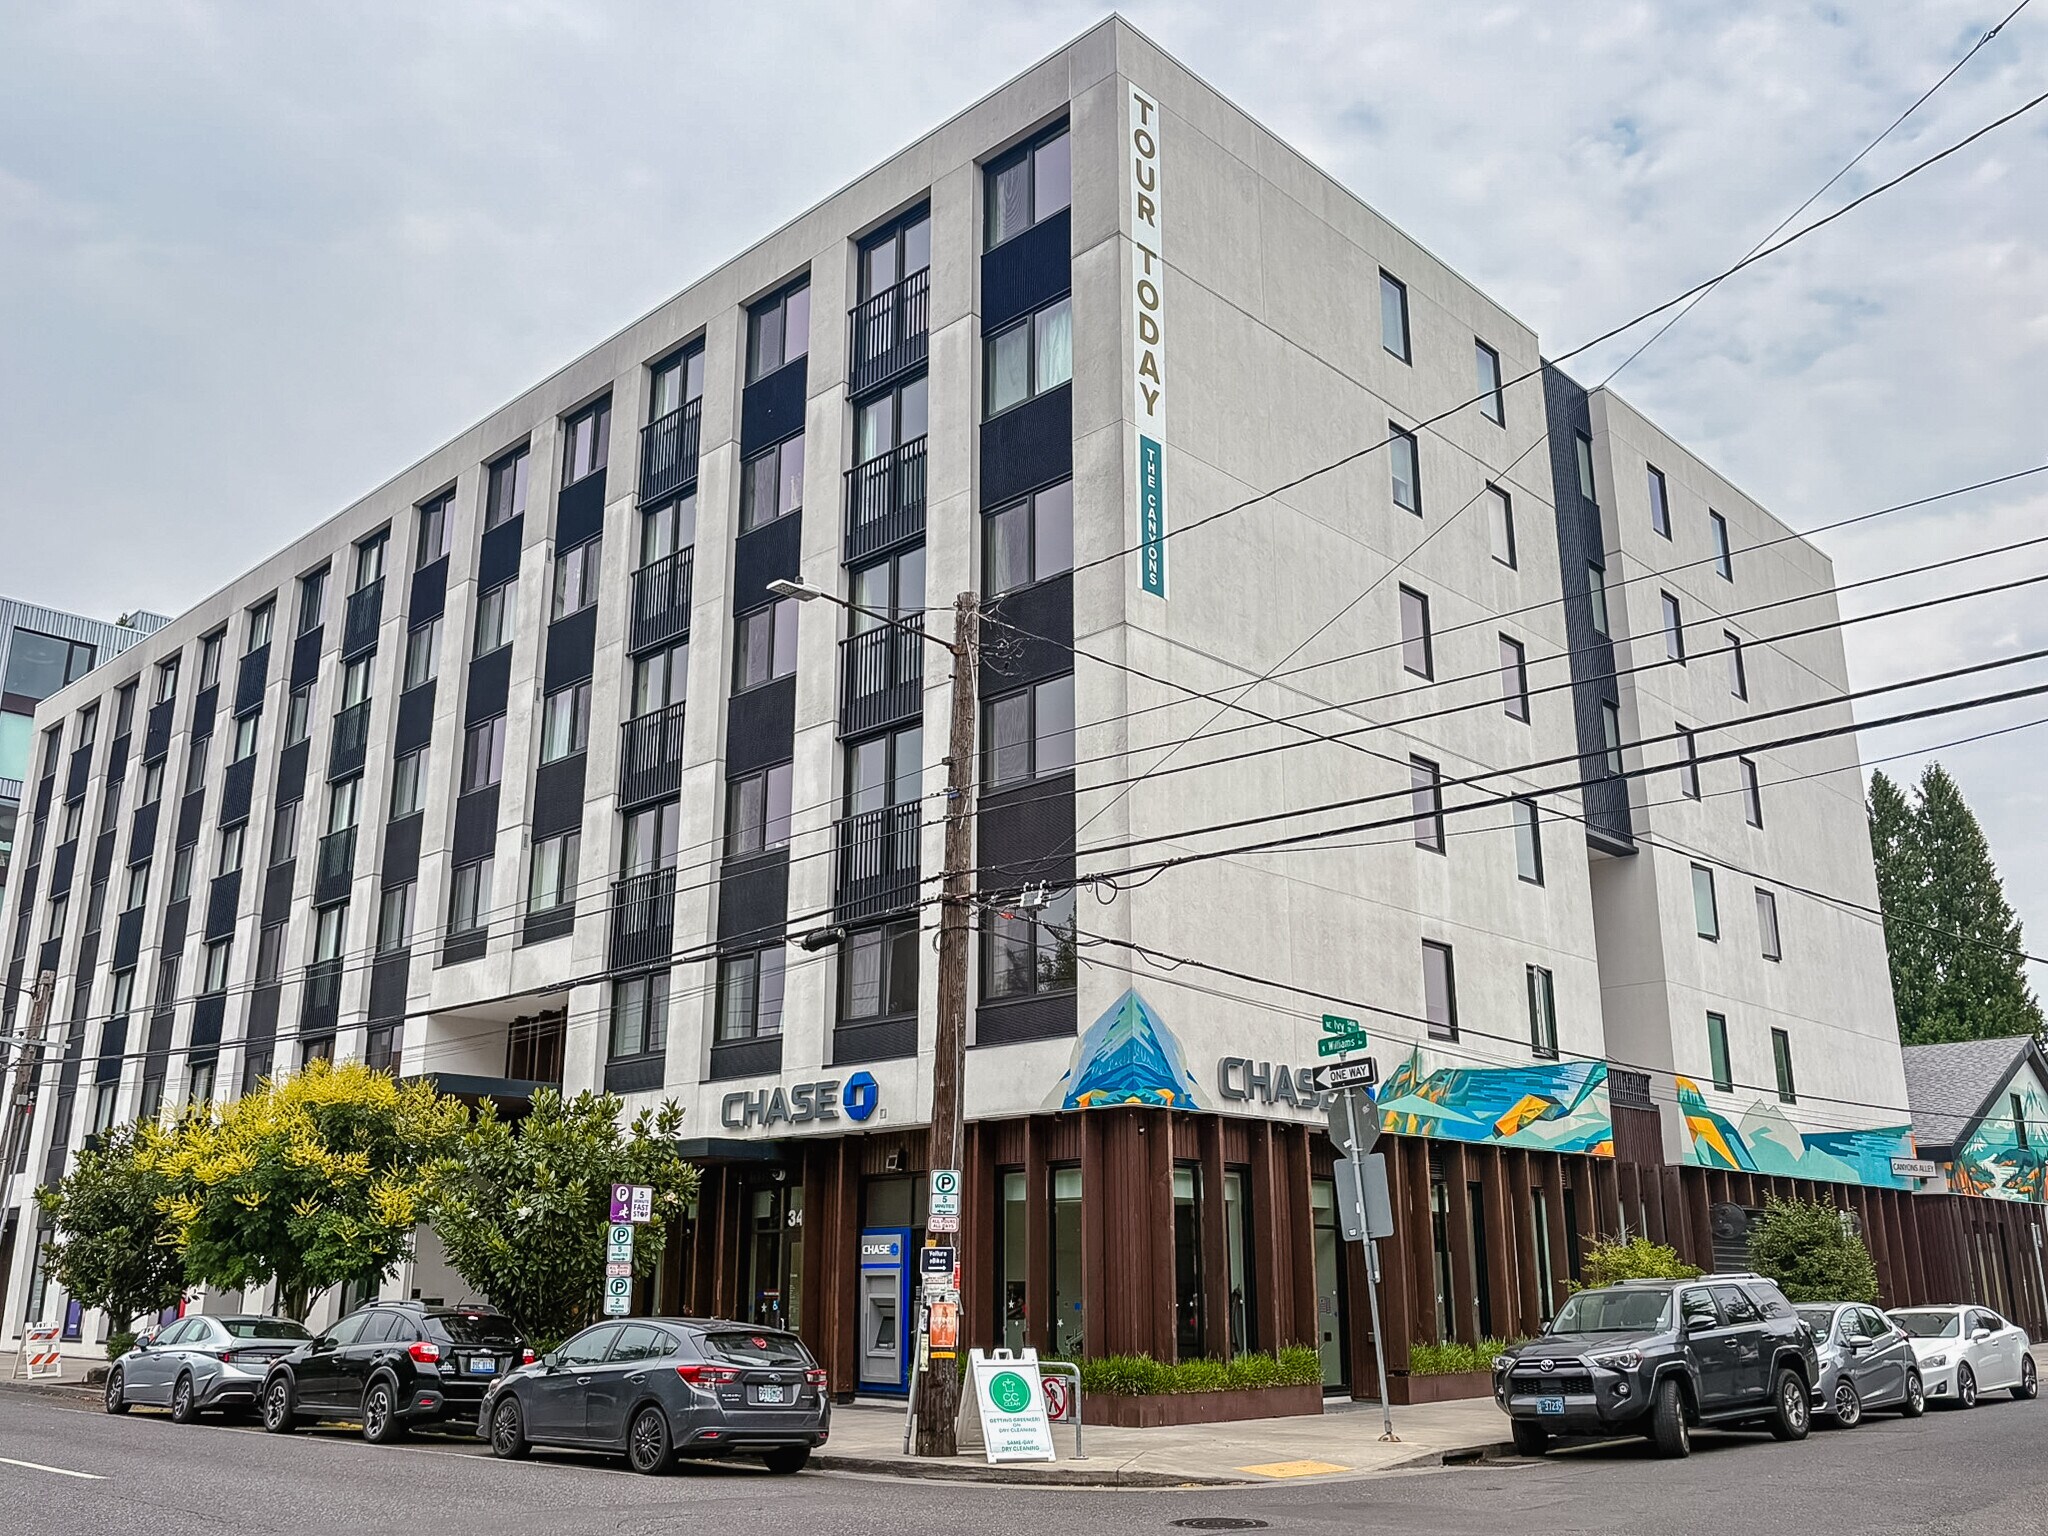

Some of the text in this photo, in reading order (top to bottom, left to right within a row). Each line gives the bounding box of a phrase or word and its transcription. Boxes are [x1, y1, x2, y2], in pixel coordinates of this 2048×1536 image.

[1133, 93, 1161, 417] TOUR TODAY
[1147, 447, 1156, 489] THE
[1333, 1020, 1345, 1033] Ivy
[1328, 1038, 1356, 1051] Williams
[1330, 1065, 1367, 1081] ONE WAY
[721, 1080, 841, 1129] CHASE
[1893, 1163, 1918, 1171] CANYONS
[639, 1191, 645, 1199] 5
[633, 1203, 649, 1211] FAST
[862, 1244, 890, 1255] CHASE
[615, 1297, 621, 1305] 2
